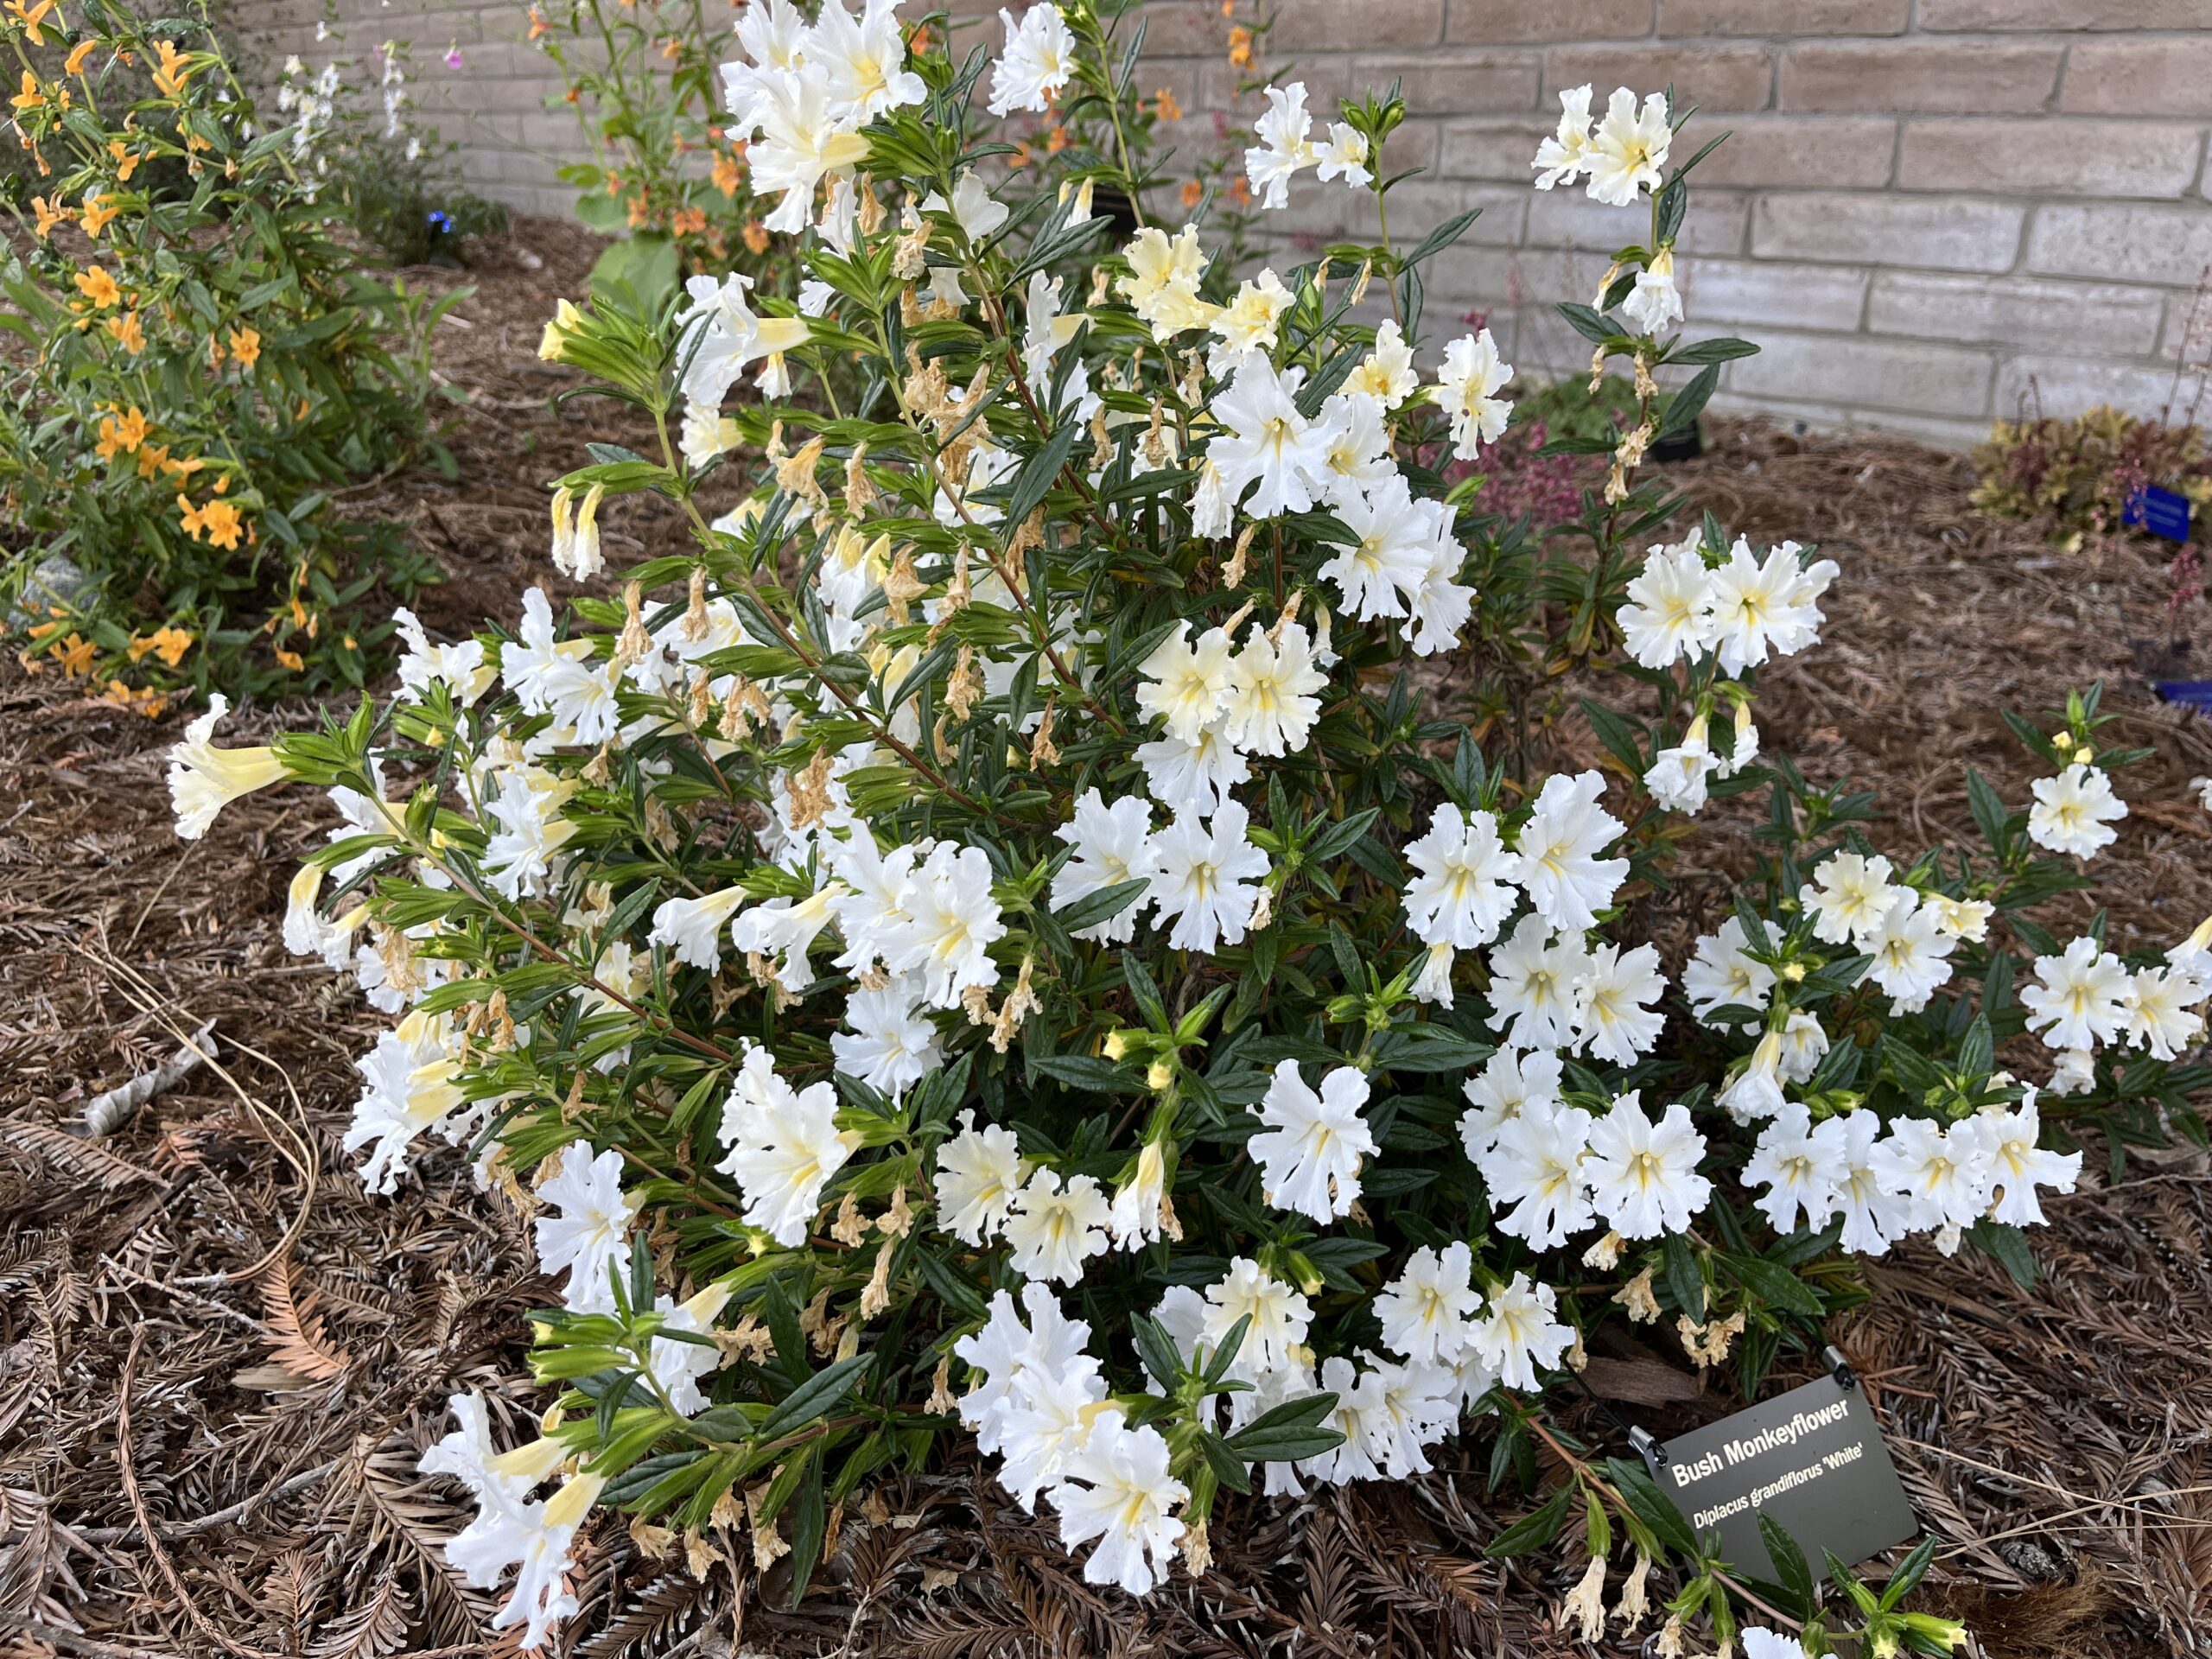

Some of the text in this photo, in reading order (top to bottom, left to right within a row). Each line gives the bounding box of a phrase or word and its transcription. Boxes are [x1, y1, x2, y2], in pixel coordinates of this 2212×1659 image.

[1672, 1399, 1848, 1487] Bush Monkeyflower
[1694, 1441, 1863, 1529] Diplacus grandiflorus 'White'
